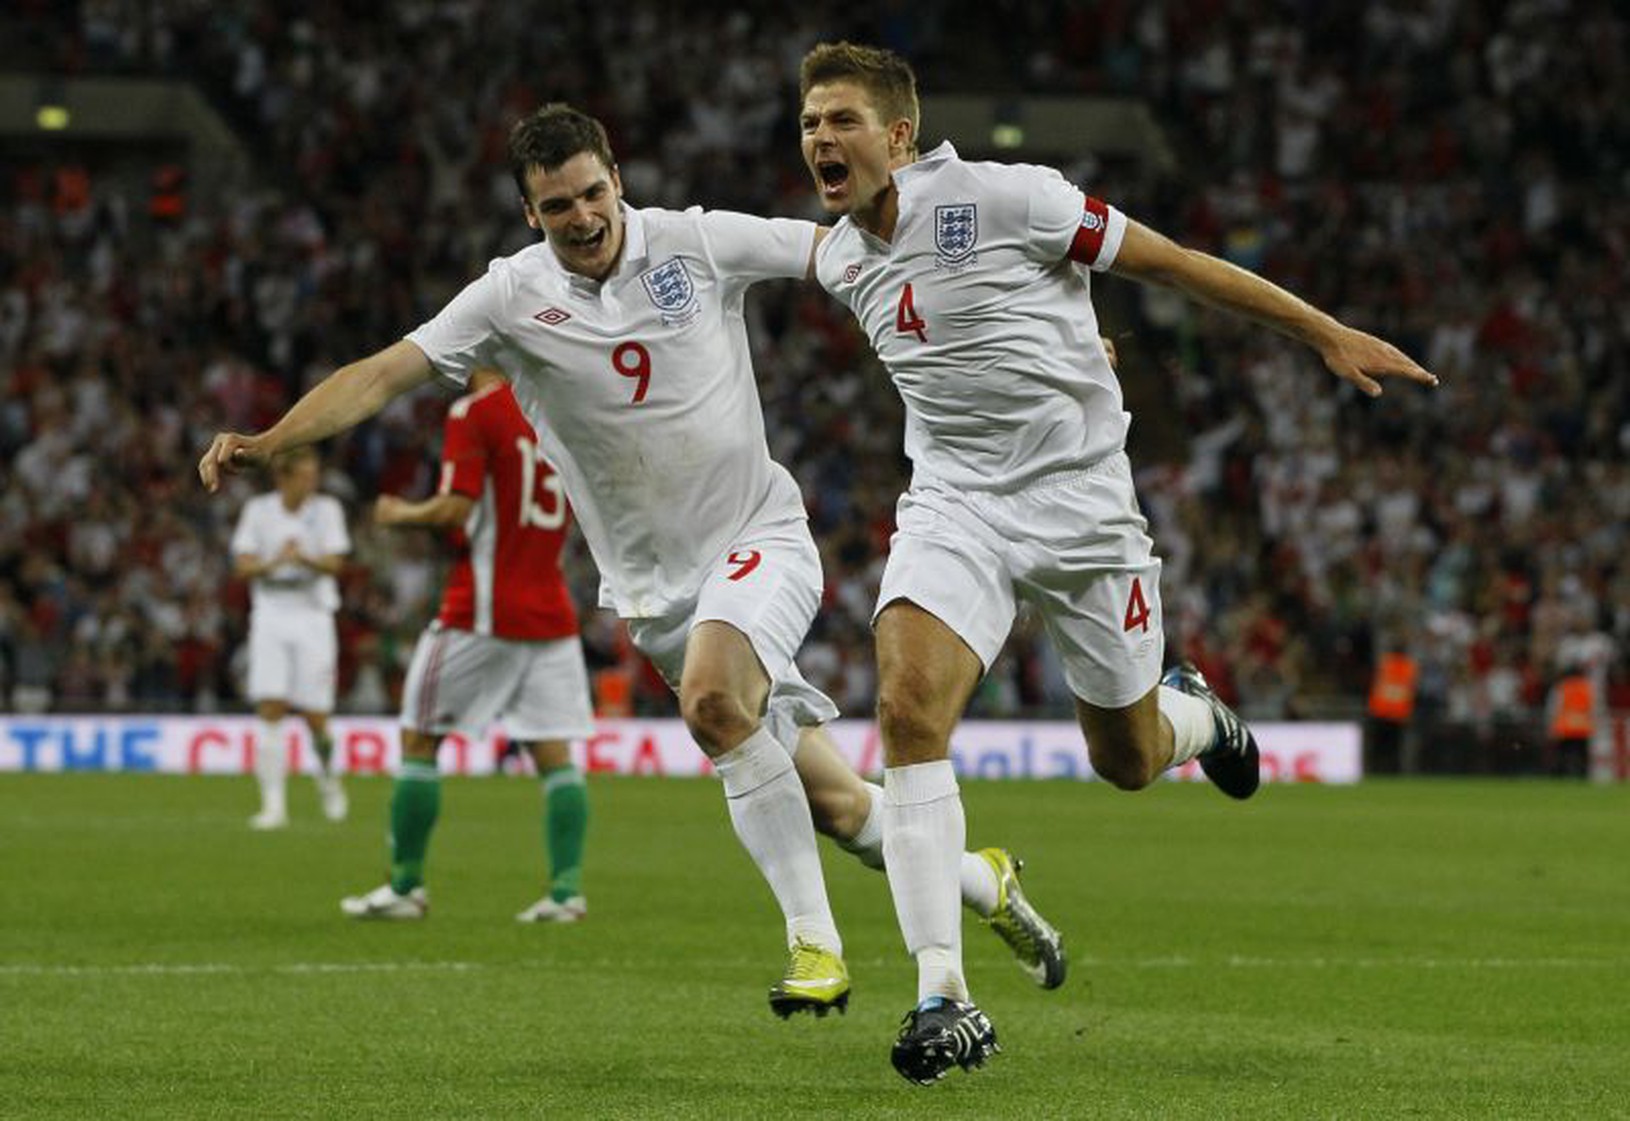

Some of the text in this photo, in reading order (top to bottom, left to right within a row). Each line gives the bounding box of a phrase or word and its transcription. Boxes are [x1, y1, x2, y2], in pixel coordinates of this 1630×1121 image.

[896, 282, 928, 343] 4
[611, 340, 652, 405] 9
[515, 437, 566, 531] 13
[727, 549, 761, 581] 9
[1124, 577, 1151, 633] 4
[8, 726, 160, 772] THE
